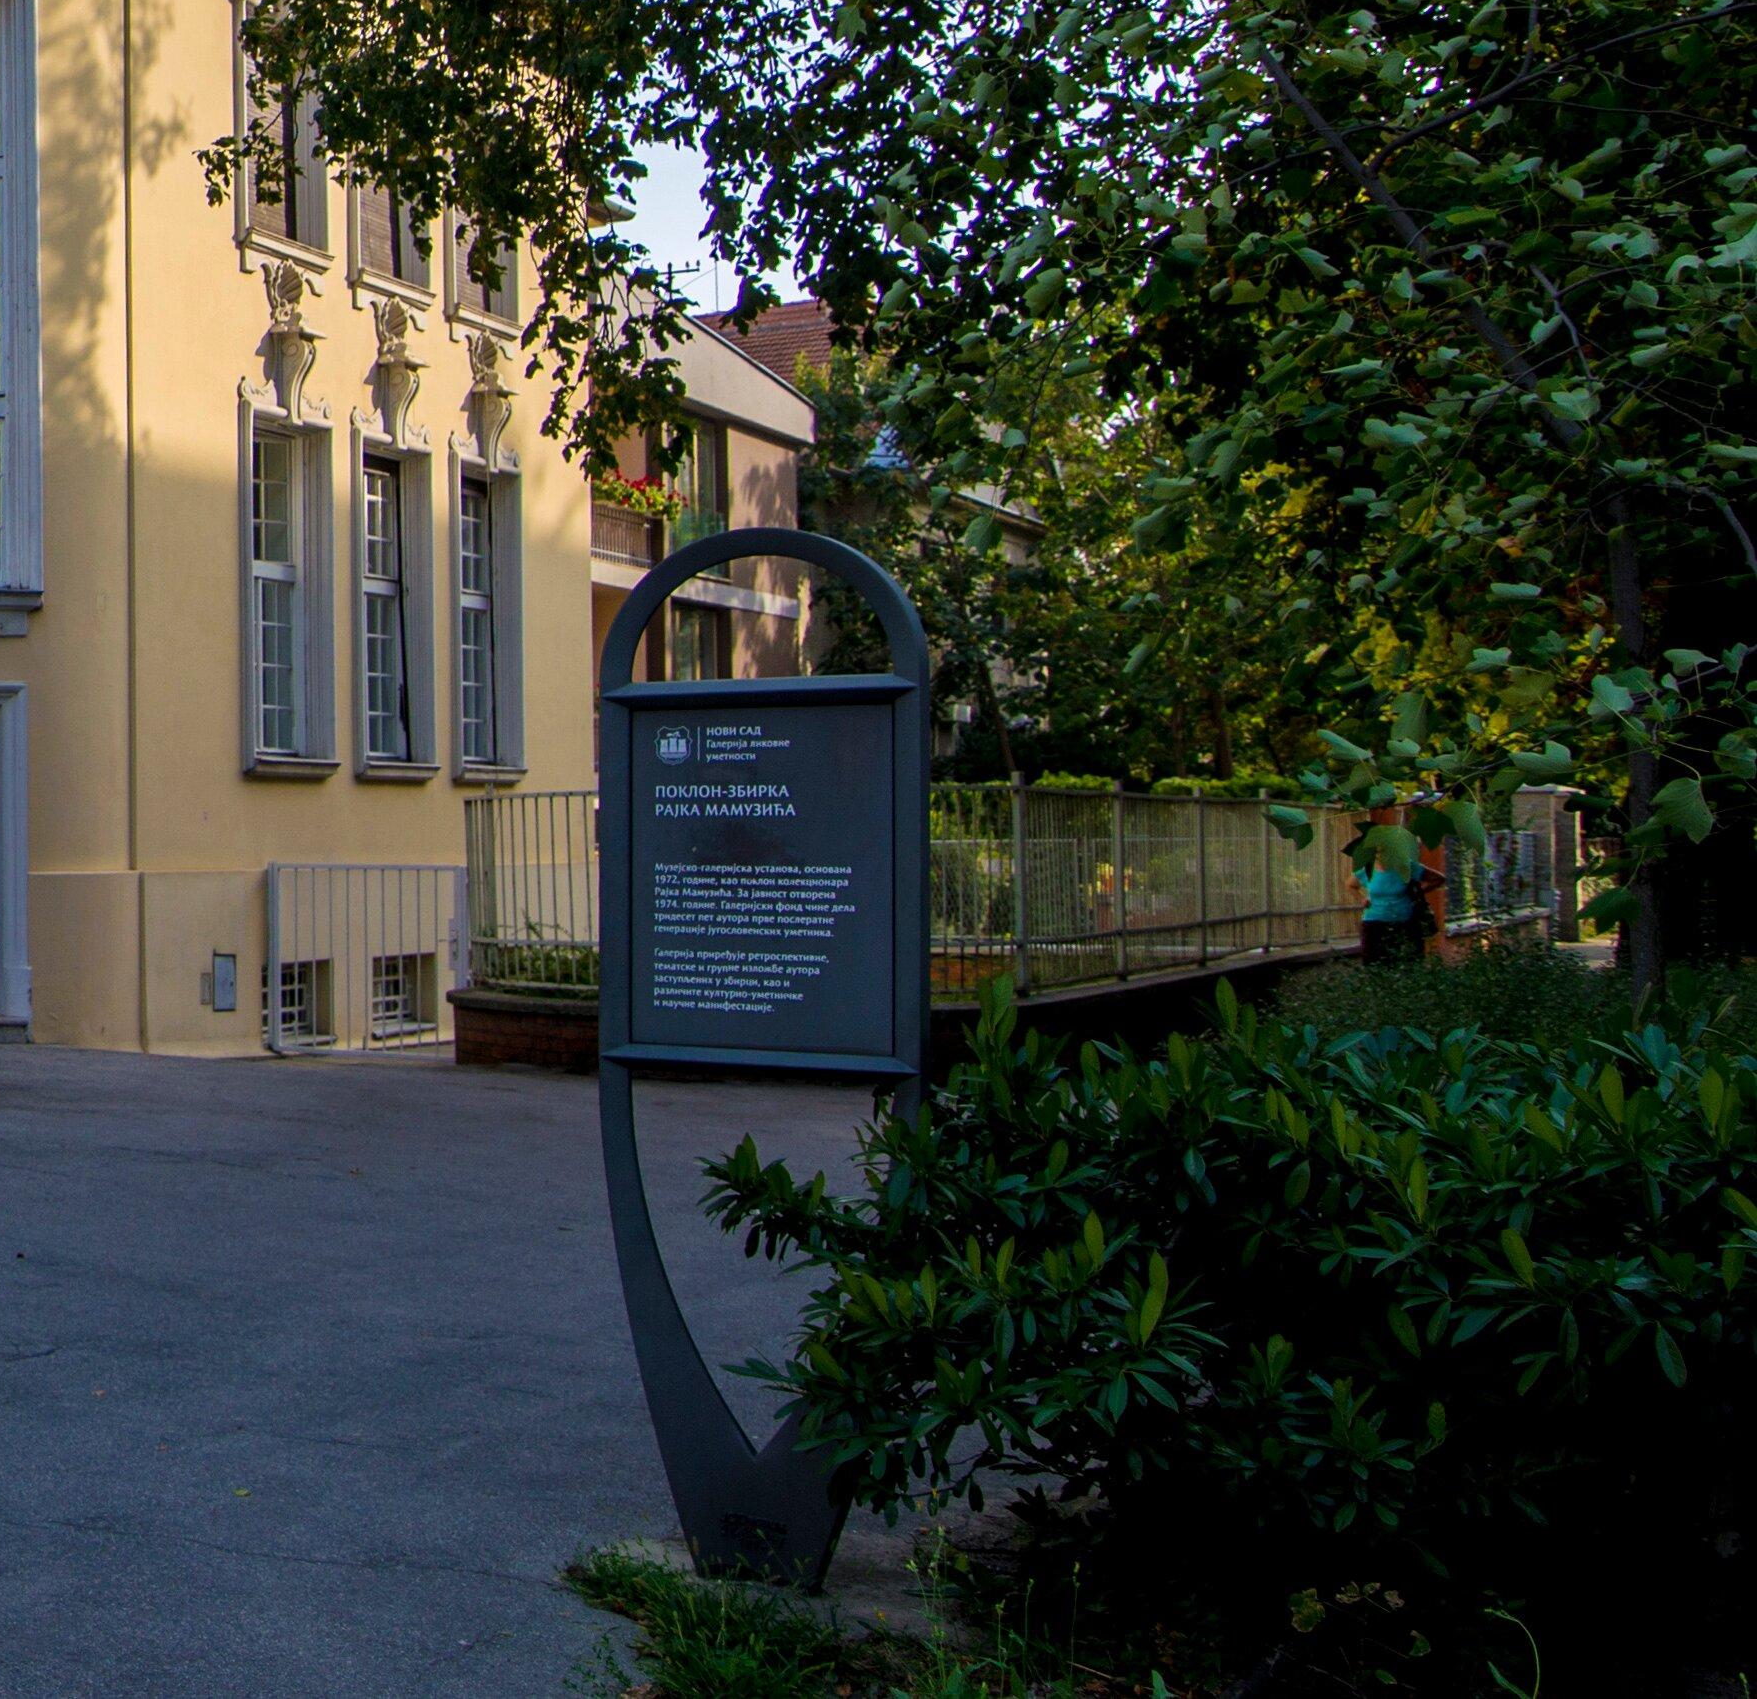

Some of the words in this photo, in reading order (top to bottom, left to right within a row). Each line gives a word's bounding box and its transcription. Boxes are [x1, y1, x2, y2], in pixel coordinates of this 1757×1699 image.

[706, 726, 737, 736] НОВИ
[739, 726, 762, 737] САД
[706, 739, 748, 750] Галерија
[750, 740, 790, 748] ликовне
[706, 753, 756, 762] уметности
[655, 785, 790, 798] ПОКЛОН-ЗБИРКА
[655, 803, 701, 818] РАЈКА
[705, 803, 796, 817] МАМУЗИЋА
[654, 863, 752, 874] Музејско-галеријска
[754, 865, 802, 875] установа,
[804, 865, 852, 874] основана
[654, 874, 680, 884] 1972.
[682, 877, 718, 886] године,
[720, 877, 738, 885] као
[778, 878, 849, 888] колекционара
[654, 887, 680, 897] Рајка
[682, 888, 734, 898] Мамузића.
[737, 888, 749, 897] За
[751, 888, 787, 899] јавност
[789, 891, 836, 900] отворена
[654, 899, 680, 908] 1974.
[682, 901, 718, 910] године.
[720, 900, 774, 912] Галеријски
[775, 902, 803, 912] фонд
[831, 904, 856, 912] дела
[654, 912, 696, 922] тридесет
[698, 913, 714, 921] пет
[716, 914, 749, 924] аутора
[752, 915, 775, 924] прве
[777, 915, 834, 925] послератне
[654, 924, 706, 934] генерације
[707, 925, 782, 936] југословенских
[784, 928, 834, 938] уметника.
[654, 947, 695, 959] Галерија
[696, 950, 746, 961] приређује
[748, 952, 829, 964] ретроспективне,
[654, 962, 696, 971] тематске
[707, 965, 740, 974] групне
[742, 964, 784, 973] изложбе
[786, 967, 820, 977] аутора
[654, 974, 713, 984] заступљених
[715, 977, 721, 986] у
[724, 976, 761, 988] збирци,
[763, 979, 781, 987] као
[654, 987, 702, 996] различите
[704, 989, 804, 1001] културно-уметничке
[662, 1000, 696, 1009] научне
[698, 1001, 775, 1014] манифестације.
